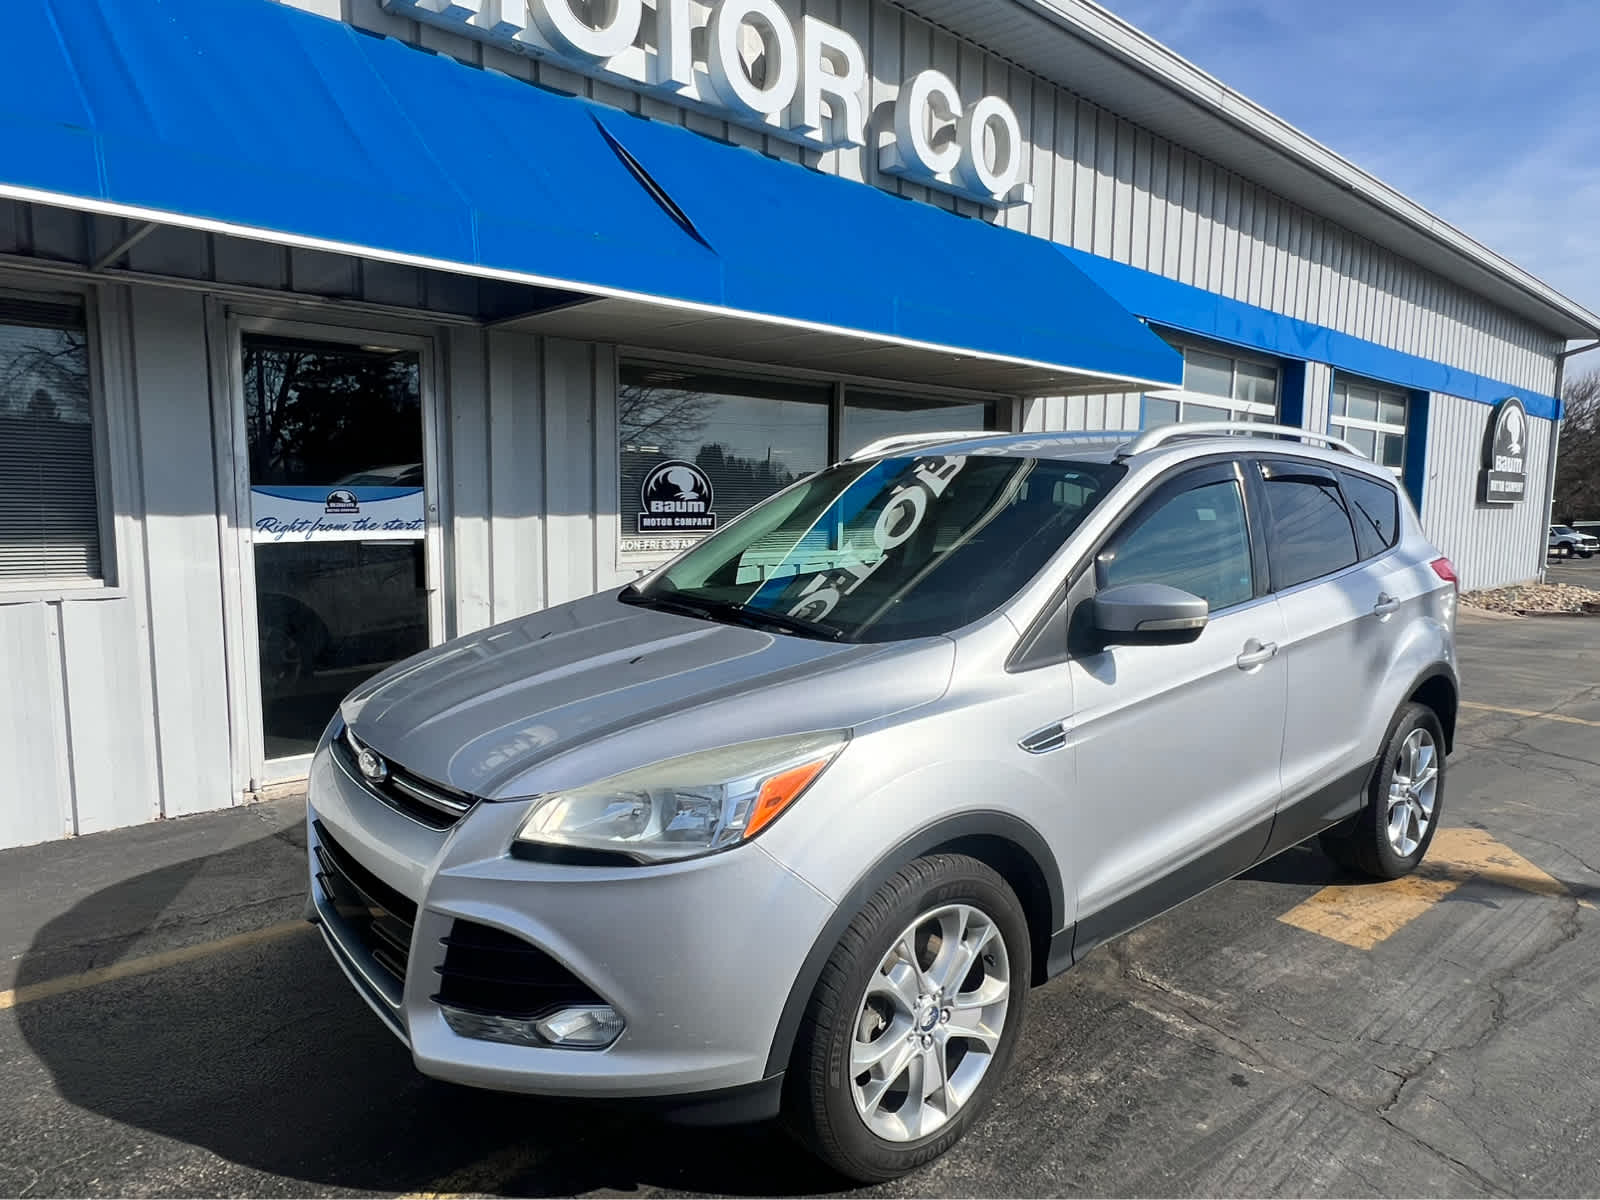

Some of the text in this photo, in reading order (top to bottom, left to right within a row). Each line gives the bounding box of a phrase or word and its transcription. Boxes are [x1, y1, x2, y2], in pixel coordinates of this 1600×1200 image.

[412, 0, 1033, 204] TOR CO.
[255, 517, 313, 541] Right
[304, 517, 350, 540] from
[349, 517, 379, 532] the
[643, 517, 713, 526] MOTOR COMPANY
